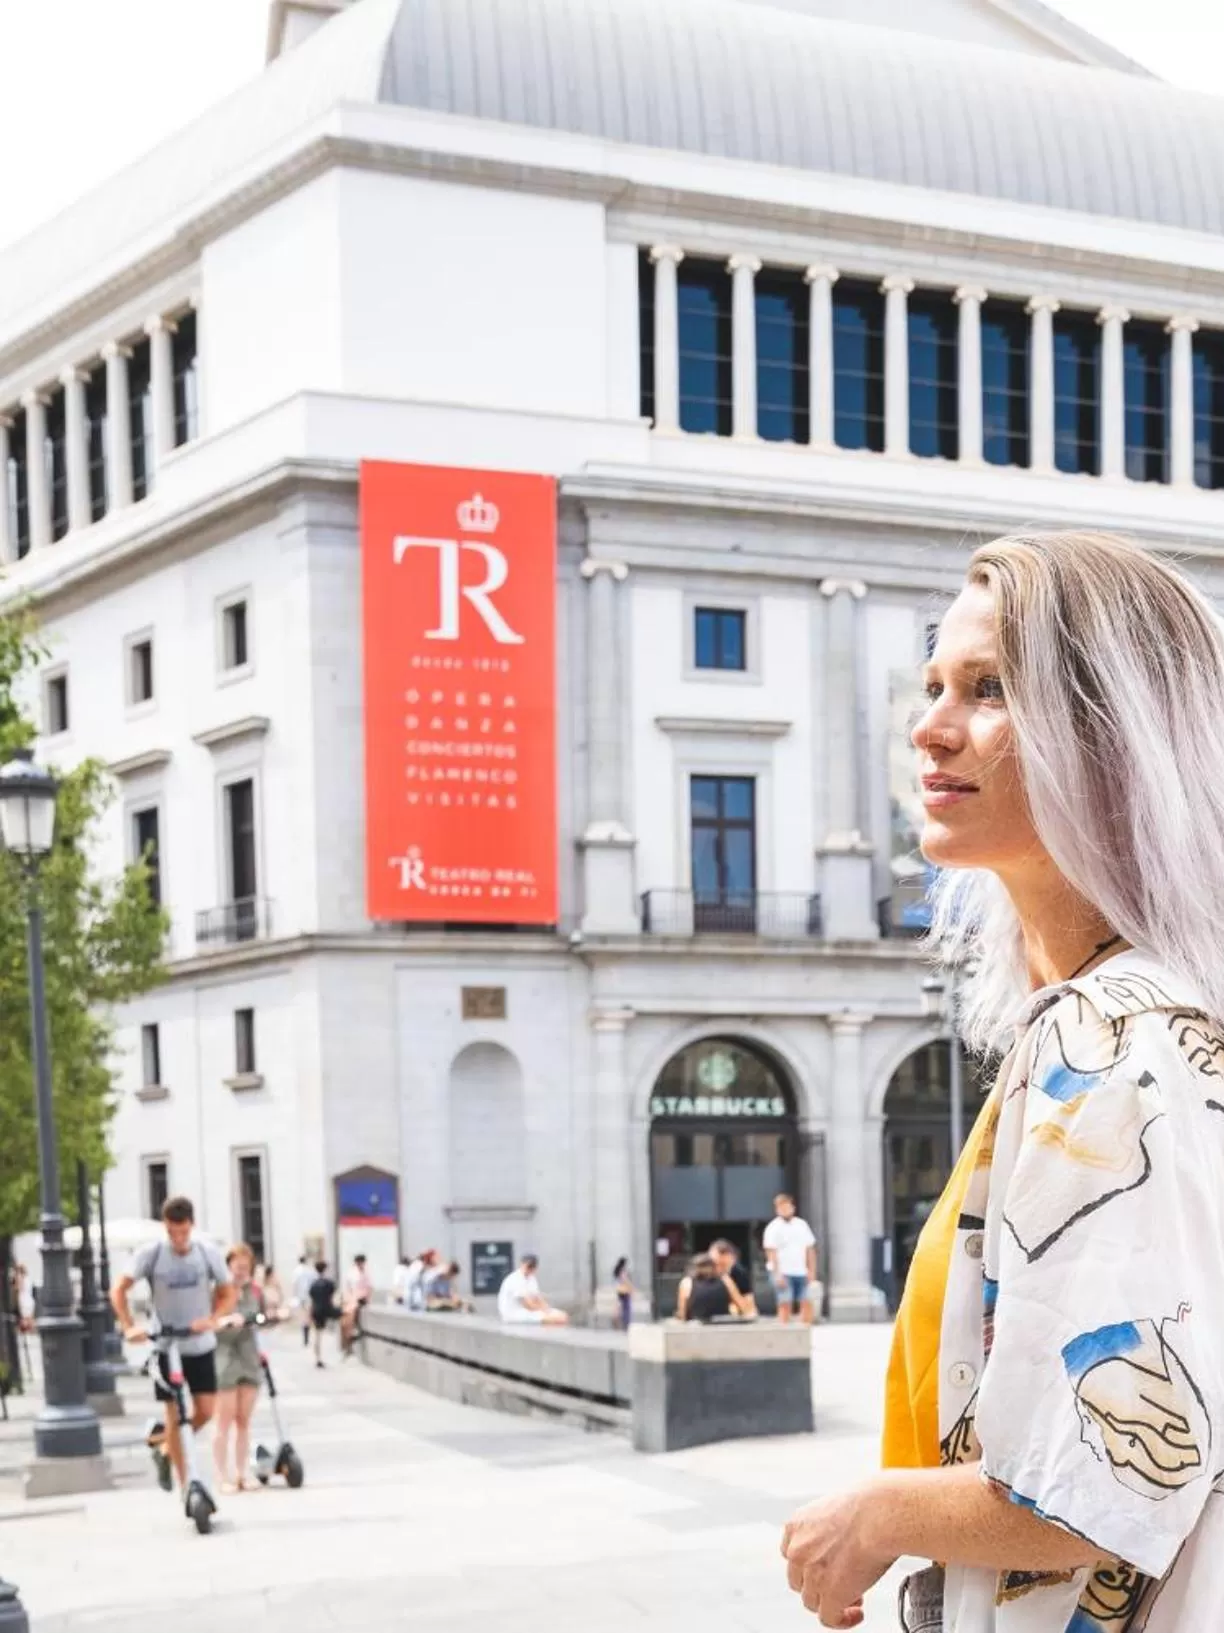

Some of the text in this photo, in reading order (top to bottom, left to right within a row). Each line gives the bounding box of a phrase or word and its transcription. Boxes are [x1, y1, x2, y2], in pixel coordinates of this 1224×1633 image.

[393, 534, 526, 645] TR
[404, 714, 517, 733] DANZA
[405, 739, 517, 760] CONCIERTOS
[405, 764, 517, 785] FLAMENCO
[406, 790, 517, 809] VISITAS
[430, 867, 535, 883] TEATRO REAL
[651, 1096, 785, 1116] STARBUCKS
